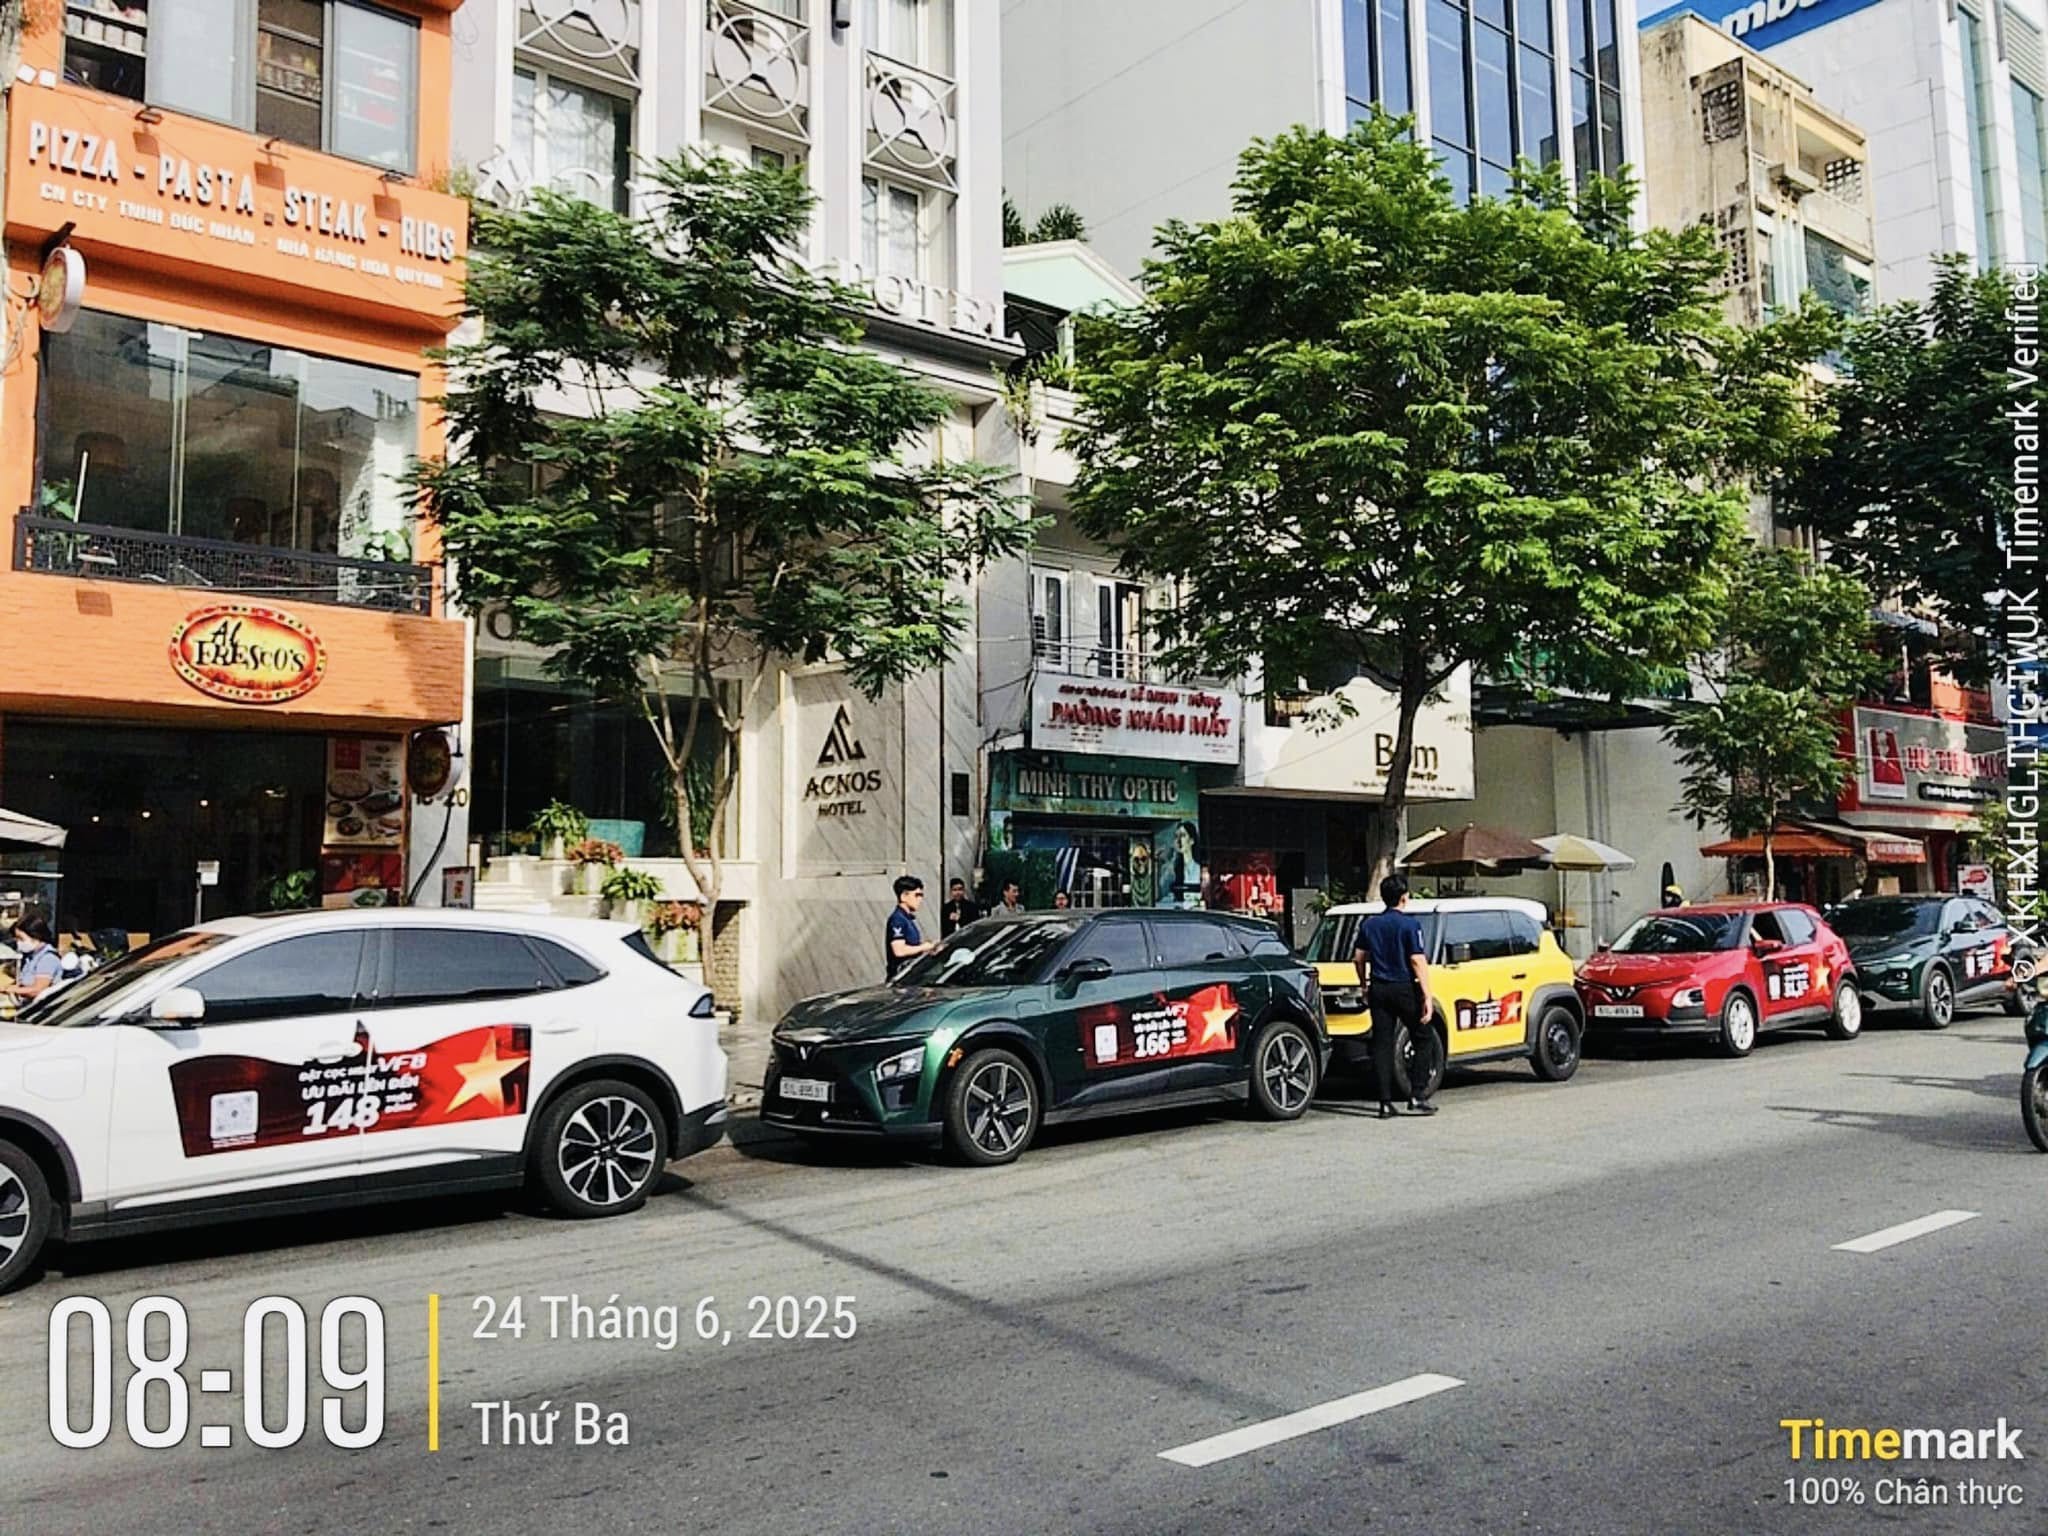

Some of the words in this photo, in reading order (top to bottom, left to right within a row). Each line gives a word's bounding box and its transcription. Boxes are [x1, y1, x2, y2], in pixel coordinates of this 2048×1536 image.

[1720, 0, 1820, 36] mb
[30, 121, 119, 185] PIZZA
[158, 153, 254, 216] PASTA
[284, 185, 367, 244] STEAK
[401, 215, 455, 264] RIBS
[1126, 707, 1185, 734] KHÁM
[1375, 733, 1438, 770] Bm
[803, 769, 882, 798] ACNOS
[1019, 770, 1071, 797] MINH
[1078, 774, 1116, 799] THY
[1123, 777, 1179, 802] OPTIC
[818, 800, 867, 817] HOTEL
[1134, 1031, 1171, 1058] 166
[302, 1095, 381, 1136] 148
